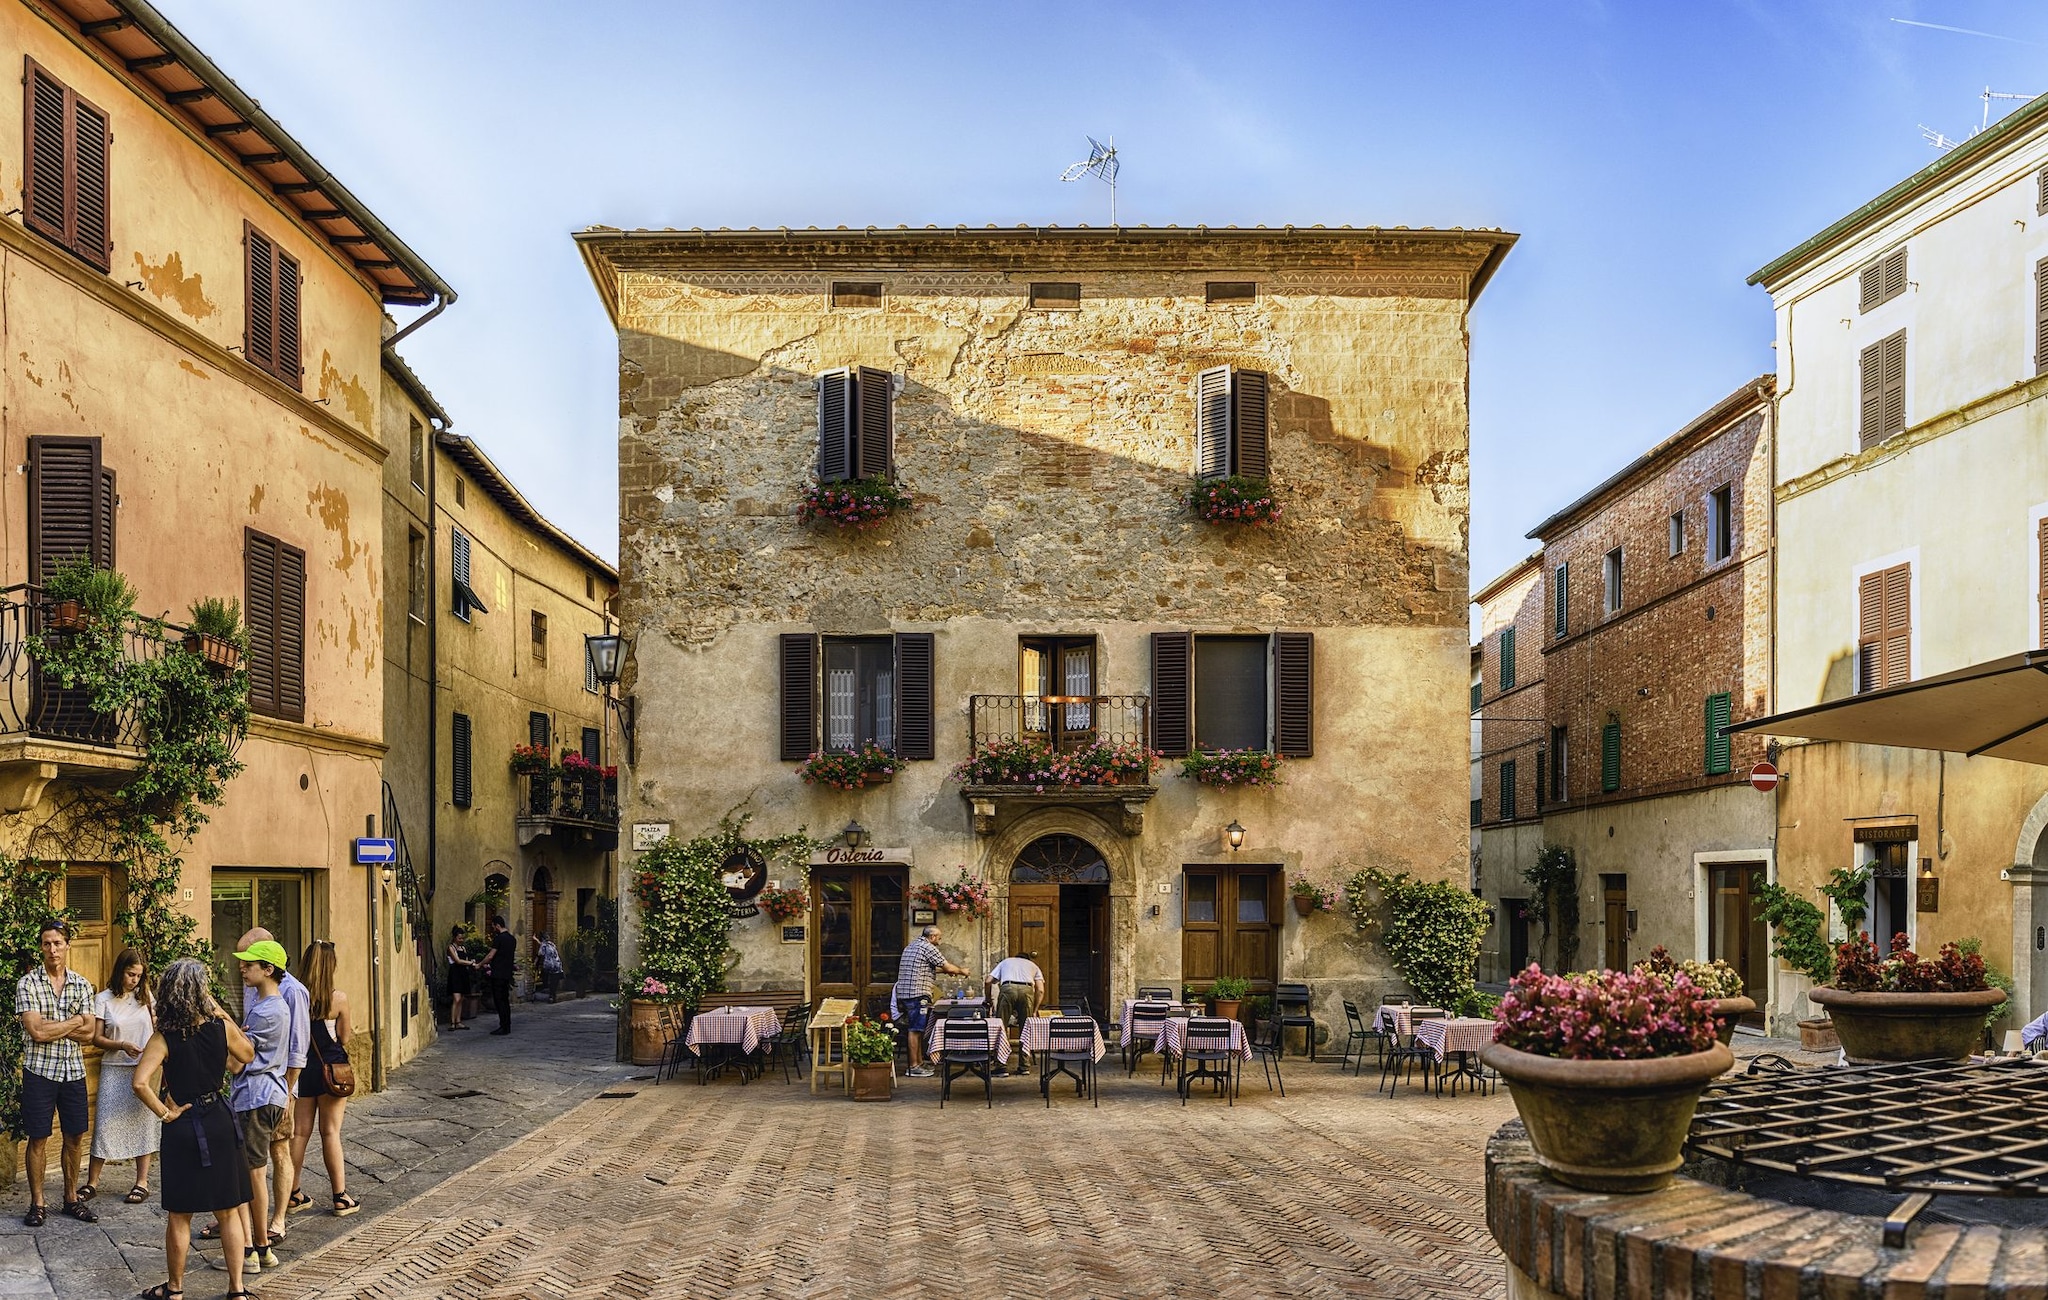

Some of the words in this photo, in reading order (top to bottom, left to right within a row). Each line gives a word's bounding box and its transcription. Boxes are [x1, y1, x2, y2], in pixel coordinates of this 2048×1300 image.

[1859, 828, 1911, 839] RISTORANTE
[737, 846, 745, 854] DI
[826, 848, 885, 863] Osteria
[727, 906, 757, 916] OSTERIA
